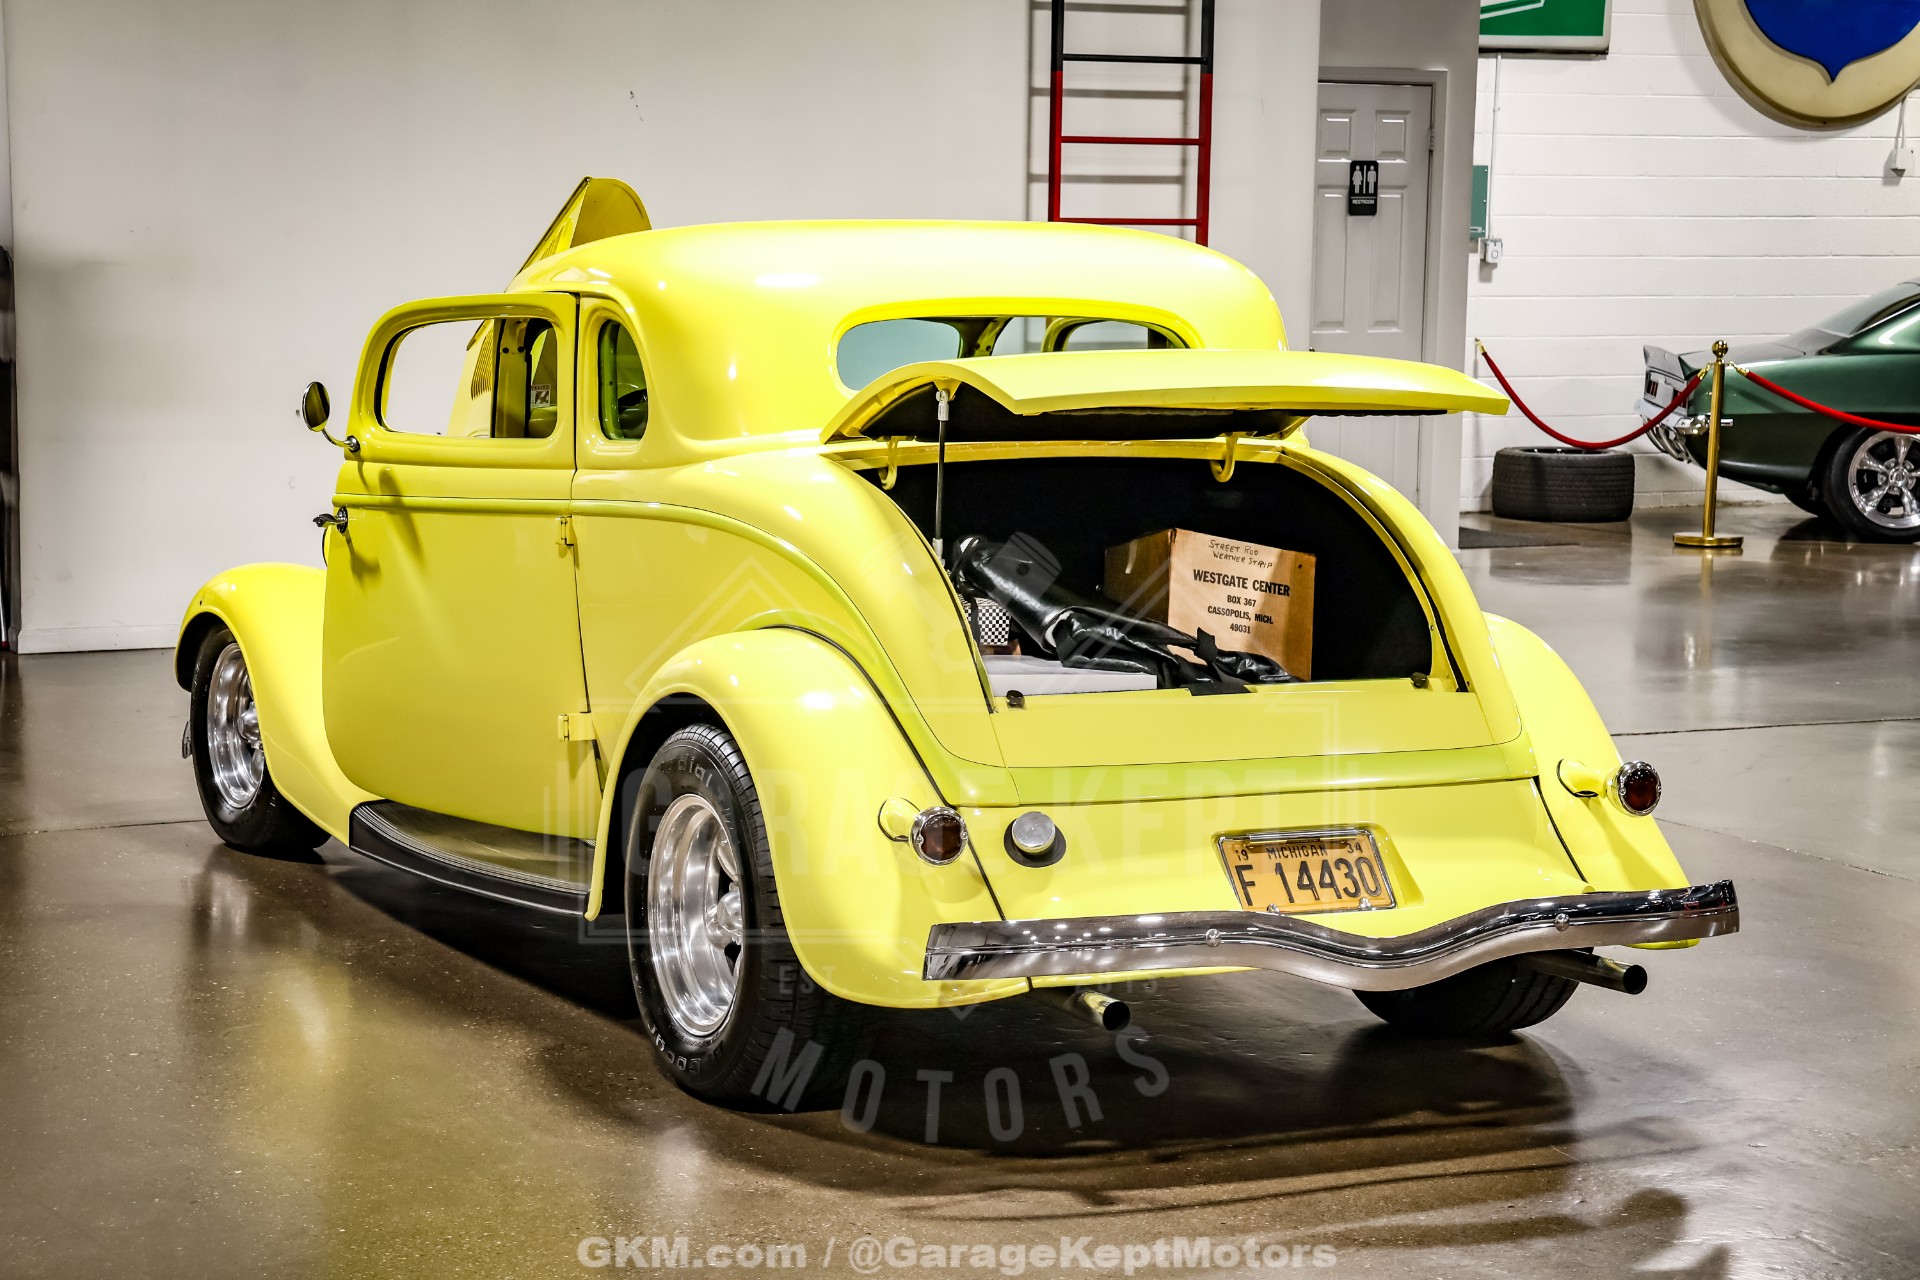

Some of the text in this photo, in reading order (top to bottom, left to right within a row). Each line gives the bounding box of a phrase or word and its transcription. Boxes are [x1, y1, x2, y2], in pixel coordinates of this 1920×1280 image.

[1208, 539, 1241, 553] STREET
[1213, 551, 1273, 569] WEATHER STRIP
[1193, 569, 1290, 597] WESTGATE CENTER
[1227, 594, 1257, 608] BOX 367
[1207, 605, 1274, 625] CASSOPOLIS, MICH.
[1229, 622, 1251, 634] 49031
[1265, 843, 1329, 861] MICHIGAN
[1347, 842, 1364, 853] 34
[1235, 856, 1382, 907] F 14430
